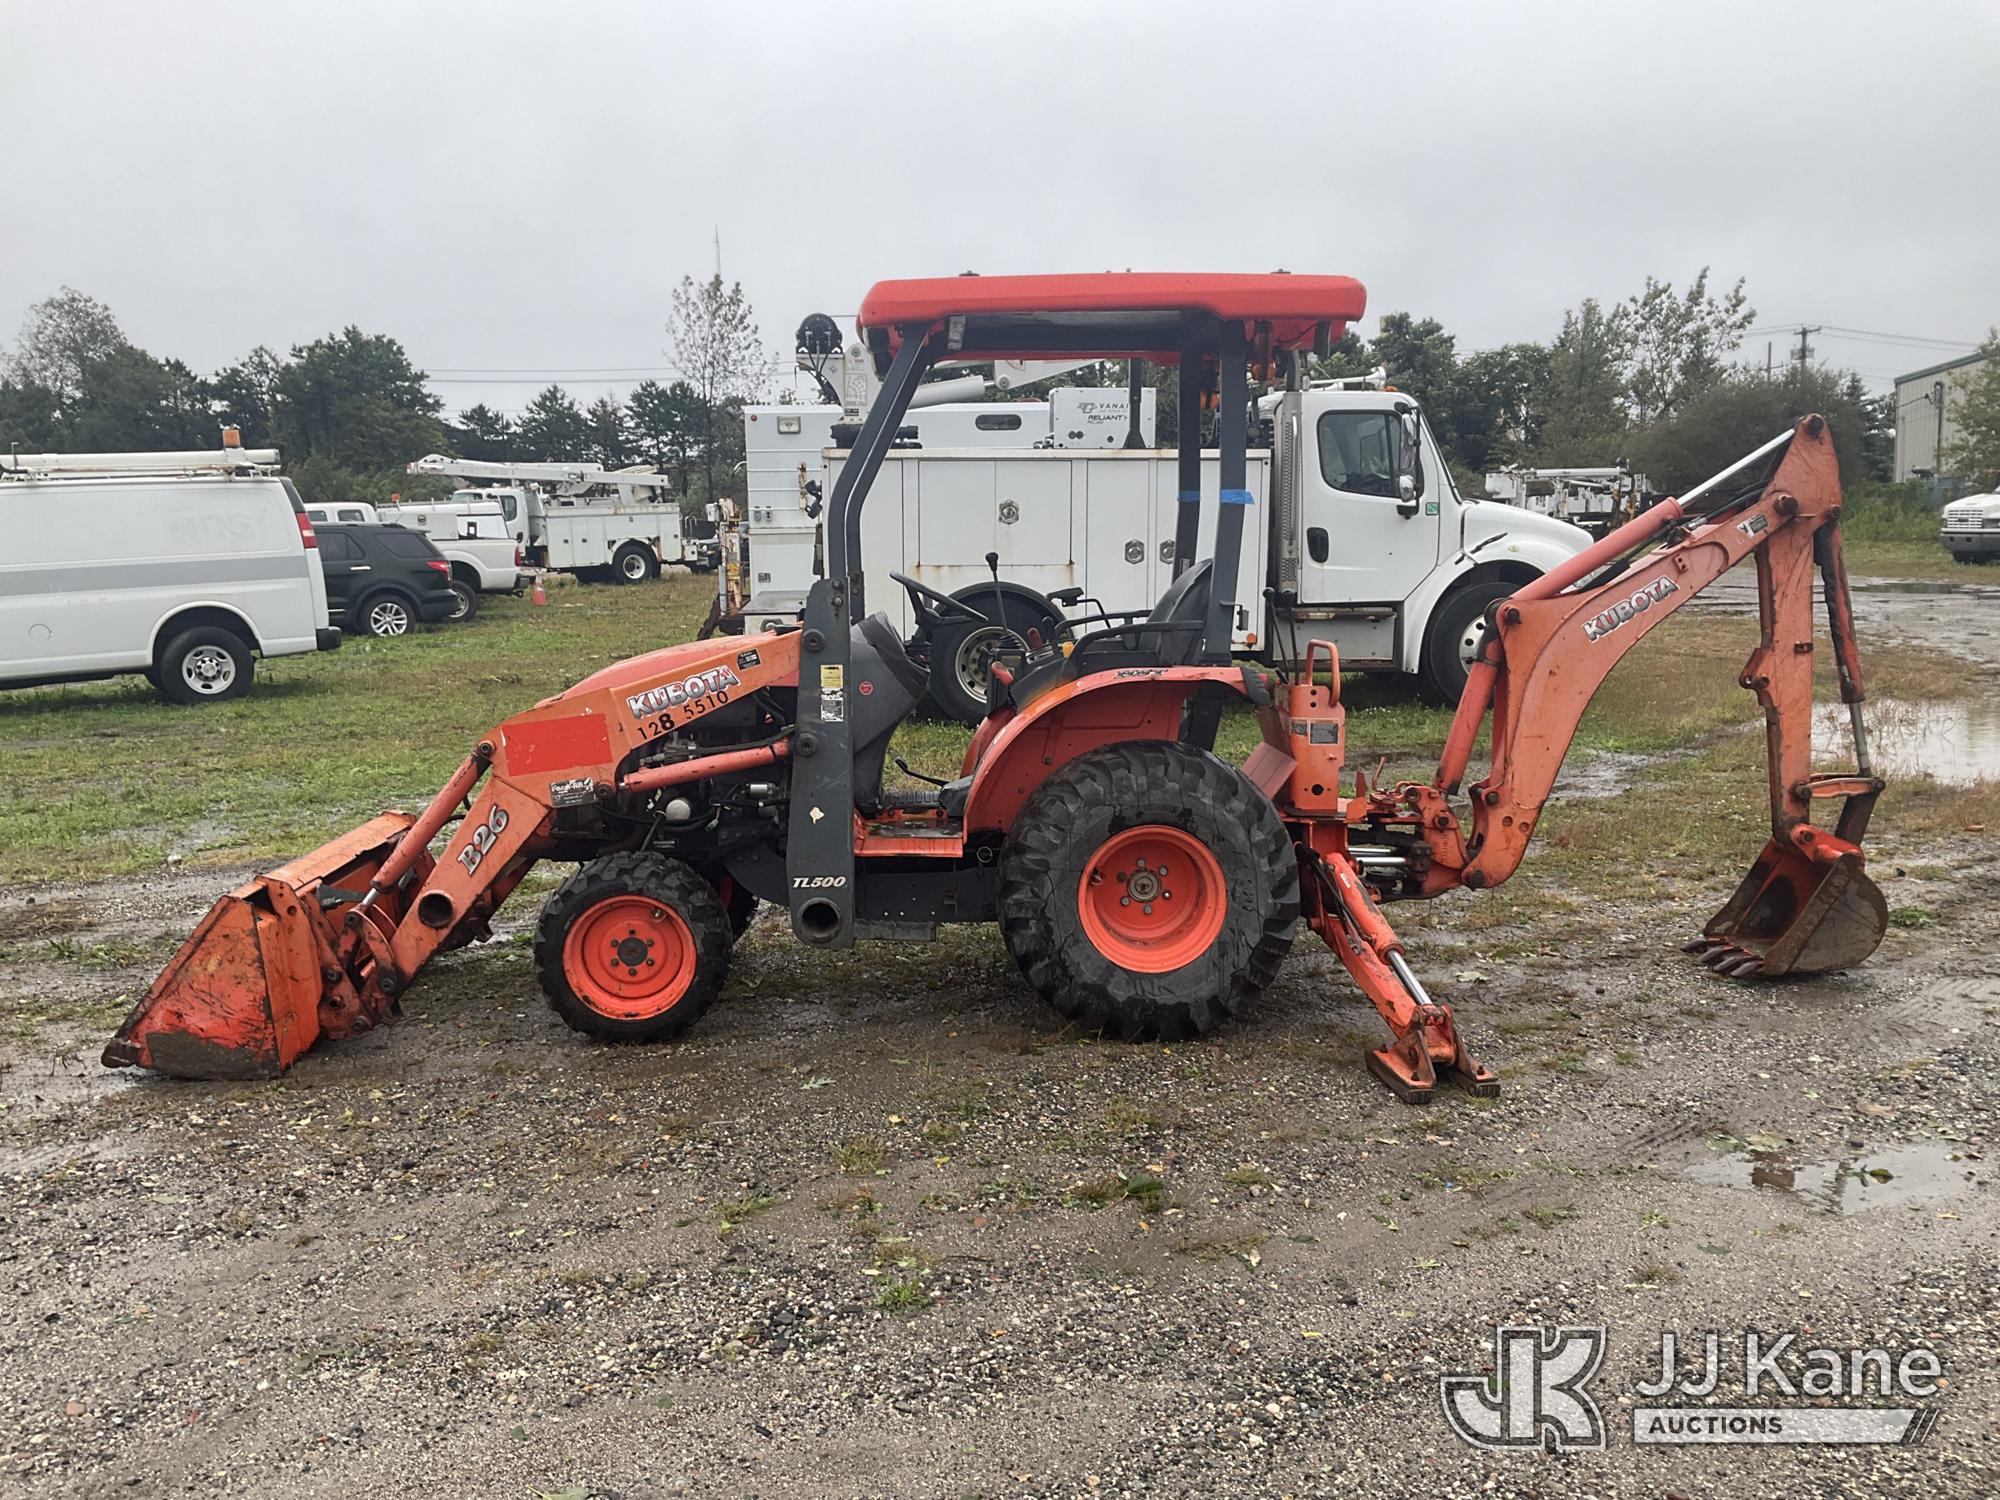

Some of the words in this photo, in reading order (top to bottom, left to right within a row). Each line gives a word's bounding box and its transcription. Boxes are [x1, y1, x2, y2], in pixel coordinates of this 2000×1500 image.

[1582, 575, 1679, 642] KUBOTA
[627, 665, 740, 719] KUBOTA
[637, 713, 675, 740] 128
[683, 691, 729, 719] 5510
[456, 803, 509, 876] B26
[793, 876, 846, 888] TL500
